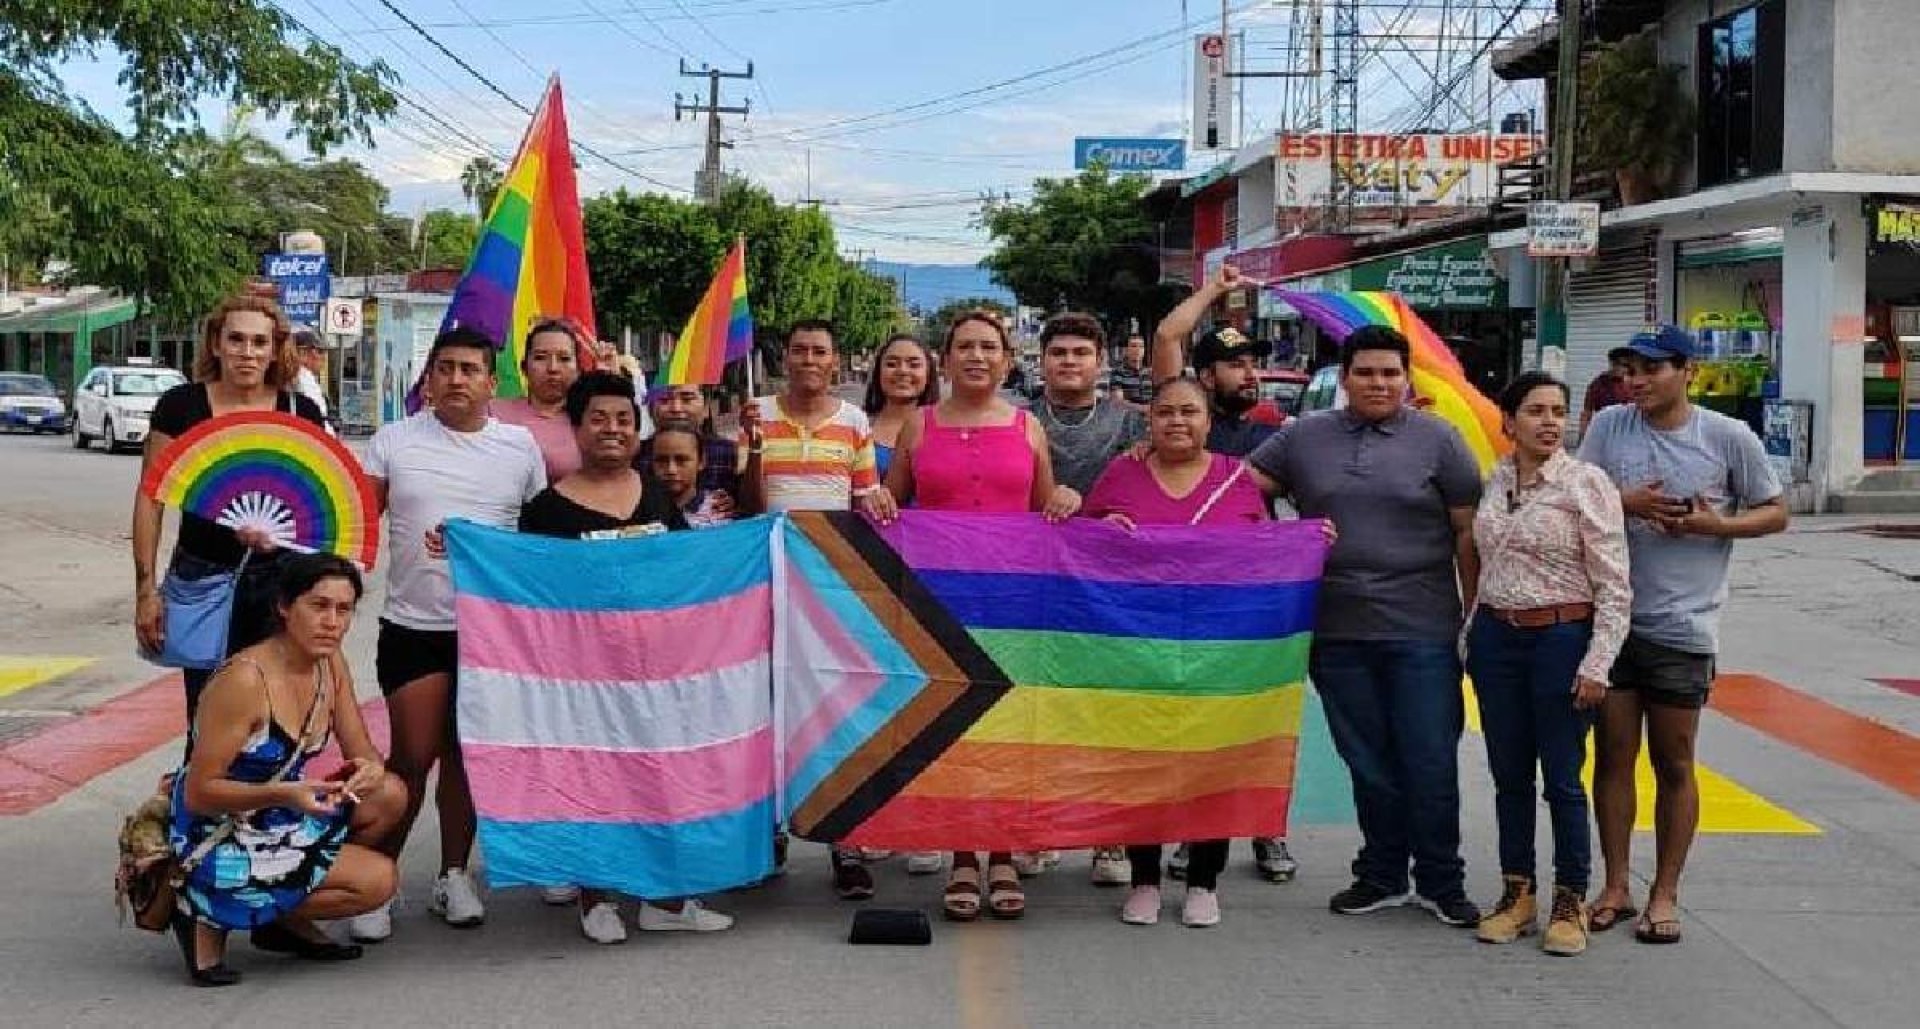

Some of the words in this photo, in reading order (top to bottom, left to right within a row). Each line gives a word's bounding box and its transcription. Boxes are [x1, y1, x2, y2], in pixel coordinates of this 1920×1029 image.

[1086, 142, 1180, 166] Comex
[1279, 134, 1428, 160] ESTETICA
[270, 256, 326, 276] telcel
